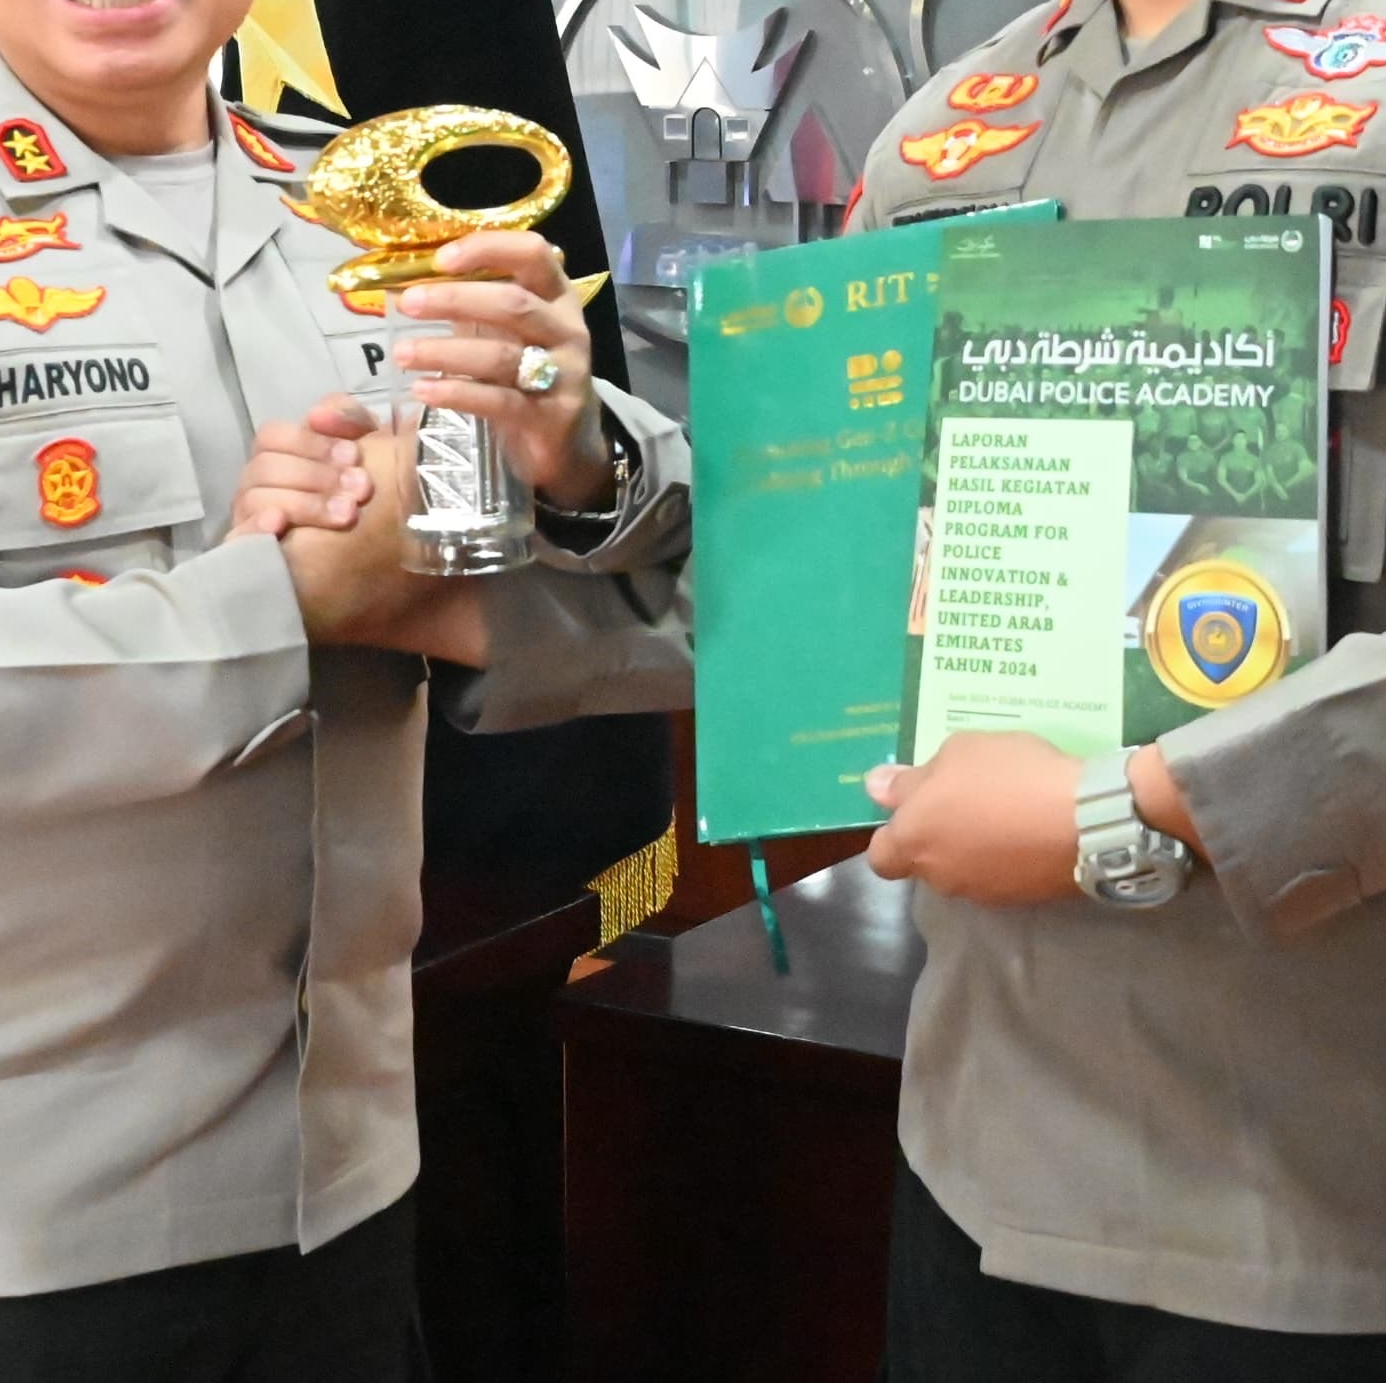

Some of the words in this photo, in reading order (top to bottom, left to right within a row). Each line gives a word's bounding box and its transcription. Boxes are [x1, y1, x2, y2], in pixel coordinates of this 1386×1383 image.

[846, 272, 915, 312] RIT
[962, 338, 1027, 372] دبي
[1029, 328, 1121, 373] شرطة
[1126, 330, 1275, 375] أكاديمية
[958, 380, 1033, 403] DUBAI
[1039, 382, 1130, 405] POLICE
[1135, 383, 1275, 407] ACADEMY
[951, 432, 1028, 448] LAPORAN
[949, 455, 1071, 472] PELAKSANAAN
[948, 477, 995, 493] HASIL
[1001, 479, 1091, 496] KEGIATAN
[946, 499, 1023, 516] DIPLOMA
[944, 522, 1029, 539] PROGRAM
[1034, 525, 1069, 540] FOR
[942, 544, 1002, 560] POLICE
[941, 566, 1051, 585] INNOVATION
[1056, 571, 1069, 587] &
[938, 589, 1050, 611] LEADERSHIP,
[937, 611, 1002, 628] UNITED
[1006, 615, 1054, 631] ARAB
[935, 633, 1024, 652] EMIRATES
[934, 656, 993, 673] TAHUN
[998, 661, 1038, 677] 2024
